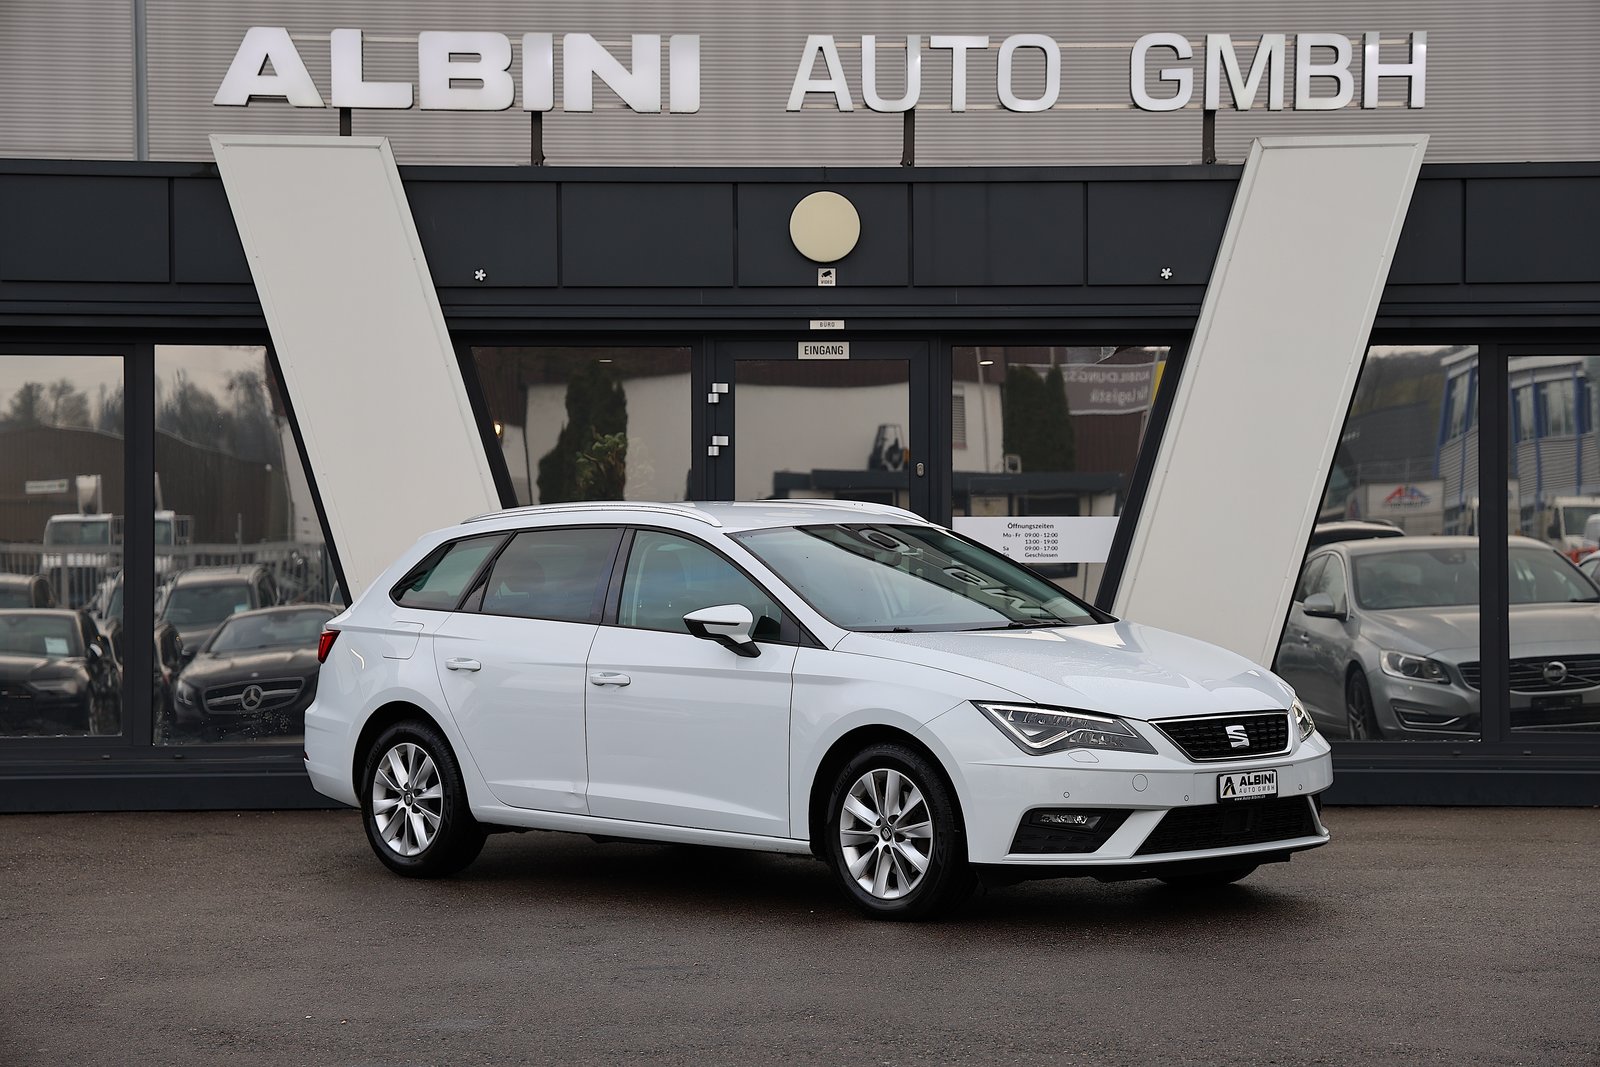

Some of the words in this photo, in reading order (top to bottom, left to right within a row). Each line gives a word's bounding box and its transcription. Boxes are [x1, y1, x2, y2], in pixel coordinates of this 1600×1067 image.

[212, 26, 700, 114] ALBINI
[785, 32, 1063, 115] AUTO
[1129, 30, 1428, 112] GMBH
[804, 345, 844, 355] EINGANG
[1007, 522, 1054, 530] Öffnungszeiten
[1239, 773, 1275, 787] ALBINI
[1238, 786, 1256, 794] AUTO
